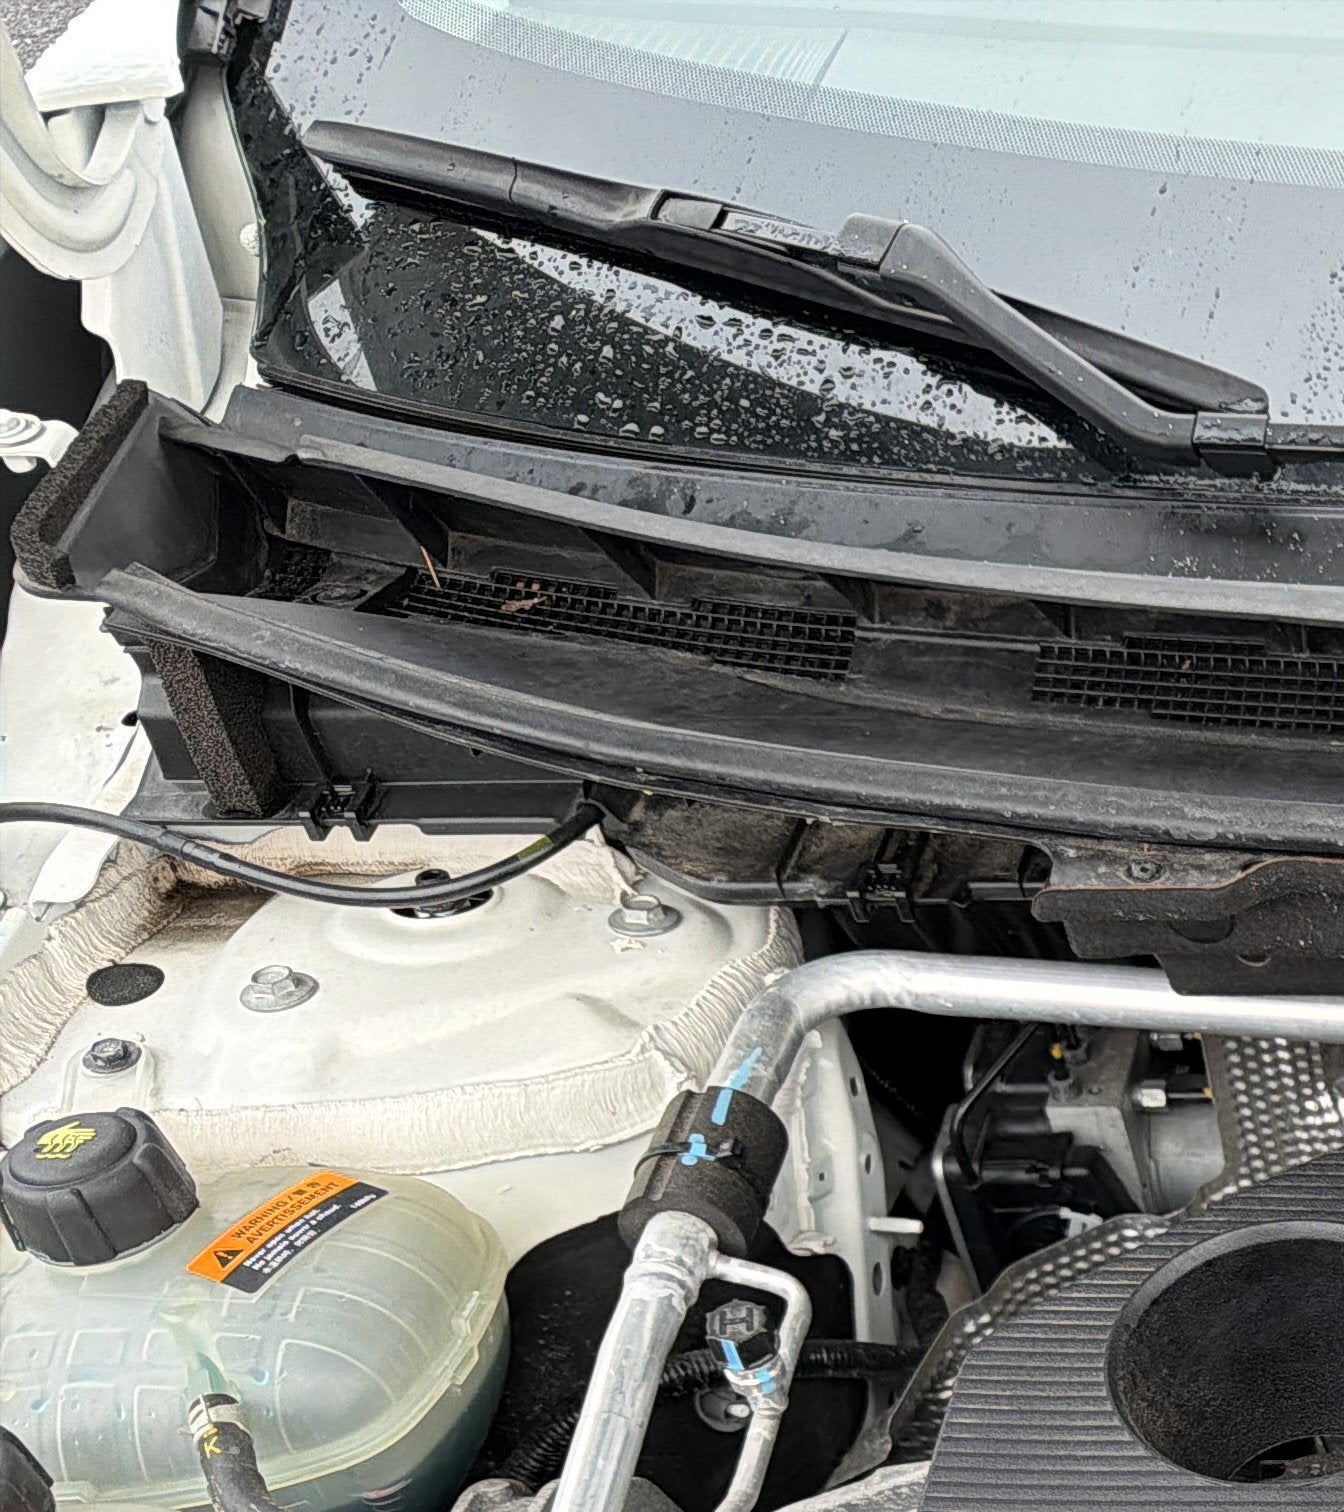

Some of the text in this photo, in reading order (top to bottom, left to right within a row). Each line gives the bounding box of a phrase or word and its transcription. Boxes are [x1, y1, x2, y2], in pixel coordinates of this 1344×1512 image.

[231, 1199, 289, 1239] WARNING
[244, 1181, 340, 1245] AVERTISSEMENT
[719, 1306, 754, 1336] H
[203, 1435, 222, 1460] K
